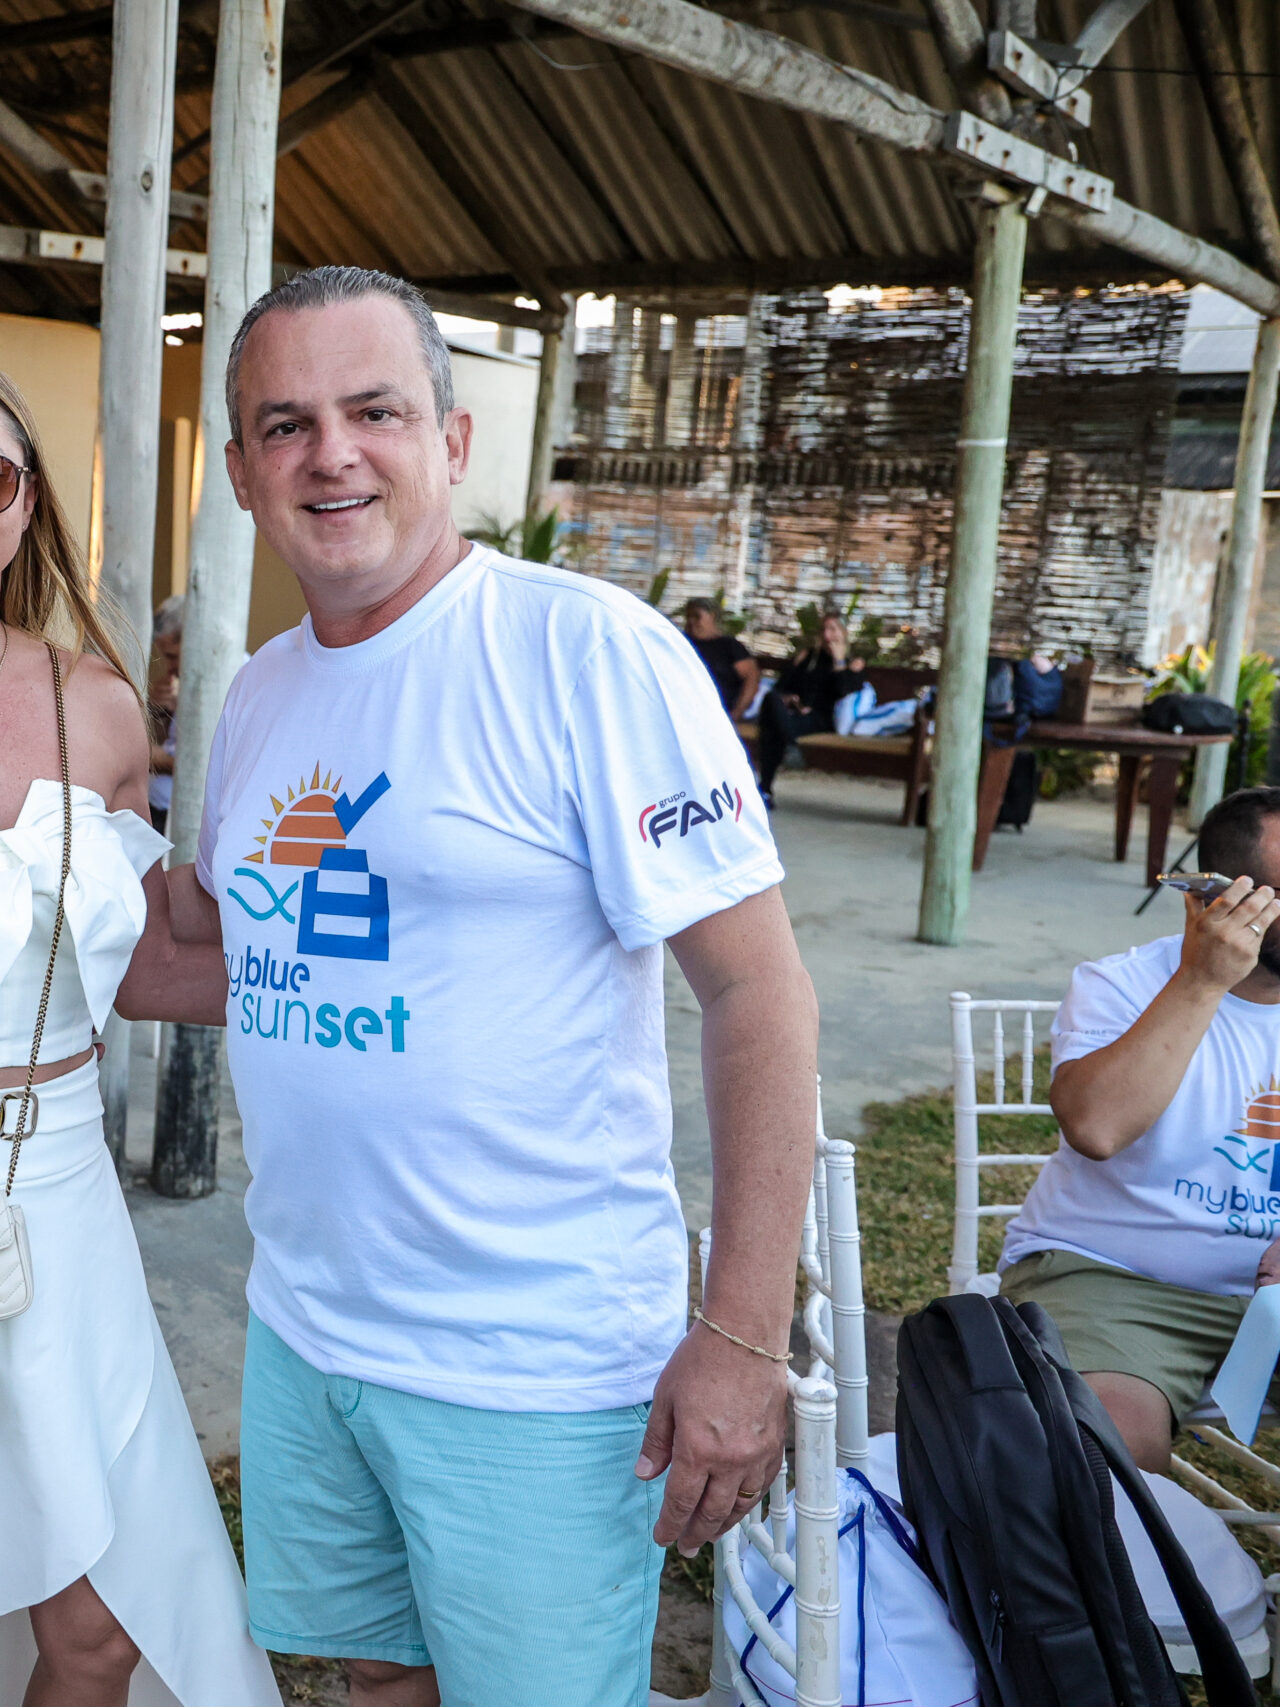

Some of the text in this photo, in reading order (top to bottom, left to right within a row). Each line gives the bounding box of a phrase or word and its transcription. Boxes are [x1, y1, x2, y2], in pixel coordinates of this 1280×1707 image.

[648, 781, 734, 849] FAN
[658, 791, 687, 809] grupo
[240, 992, 411, 1053] sunset
